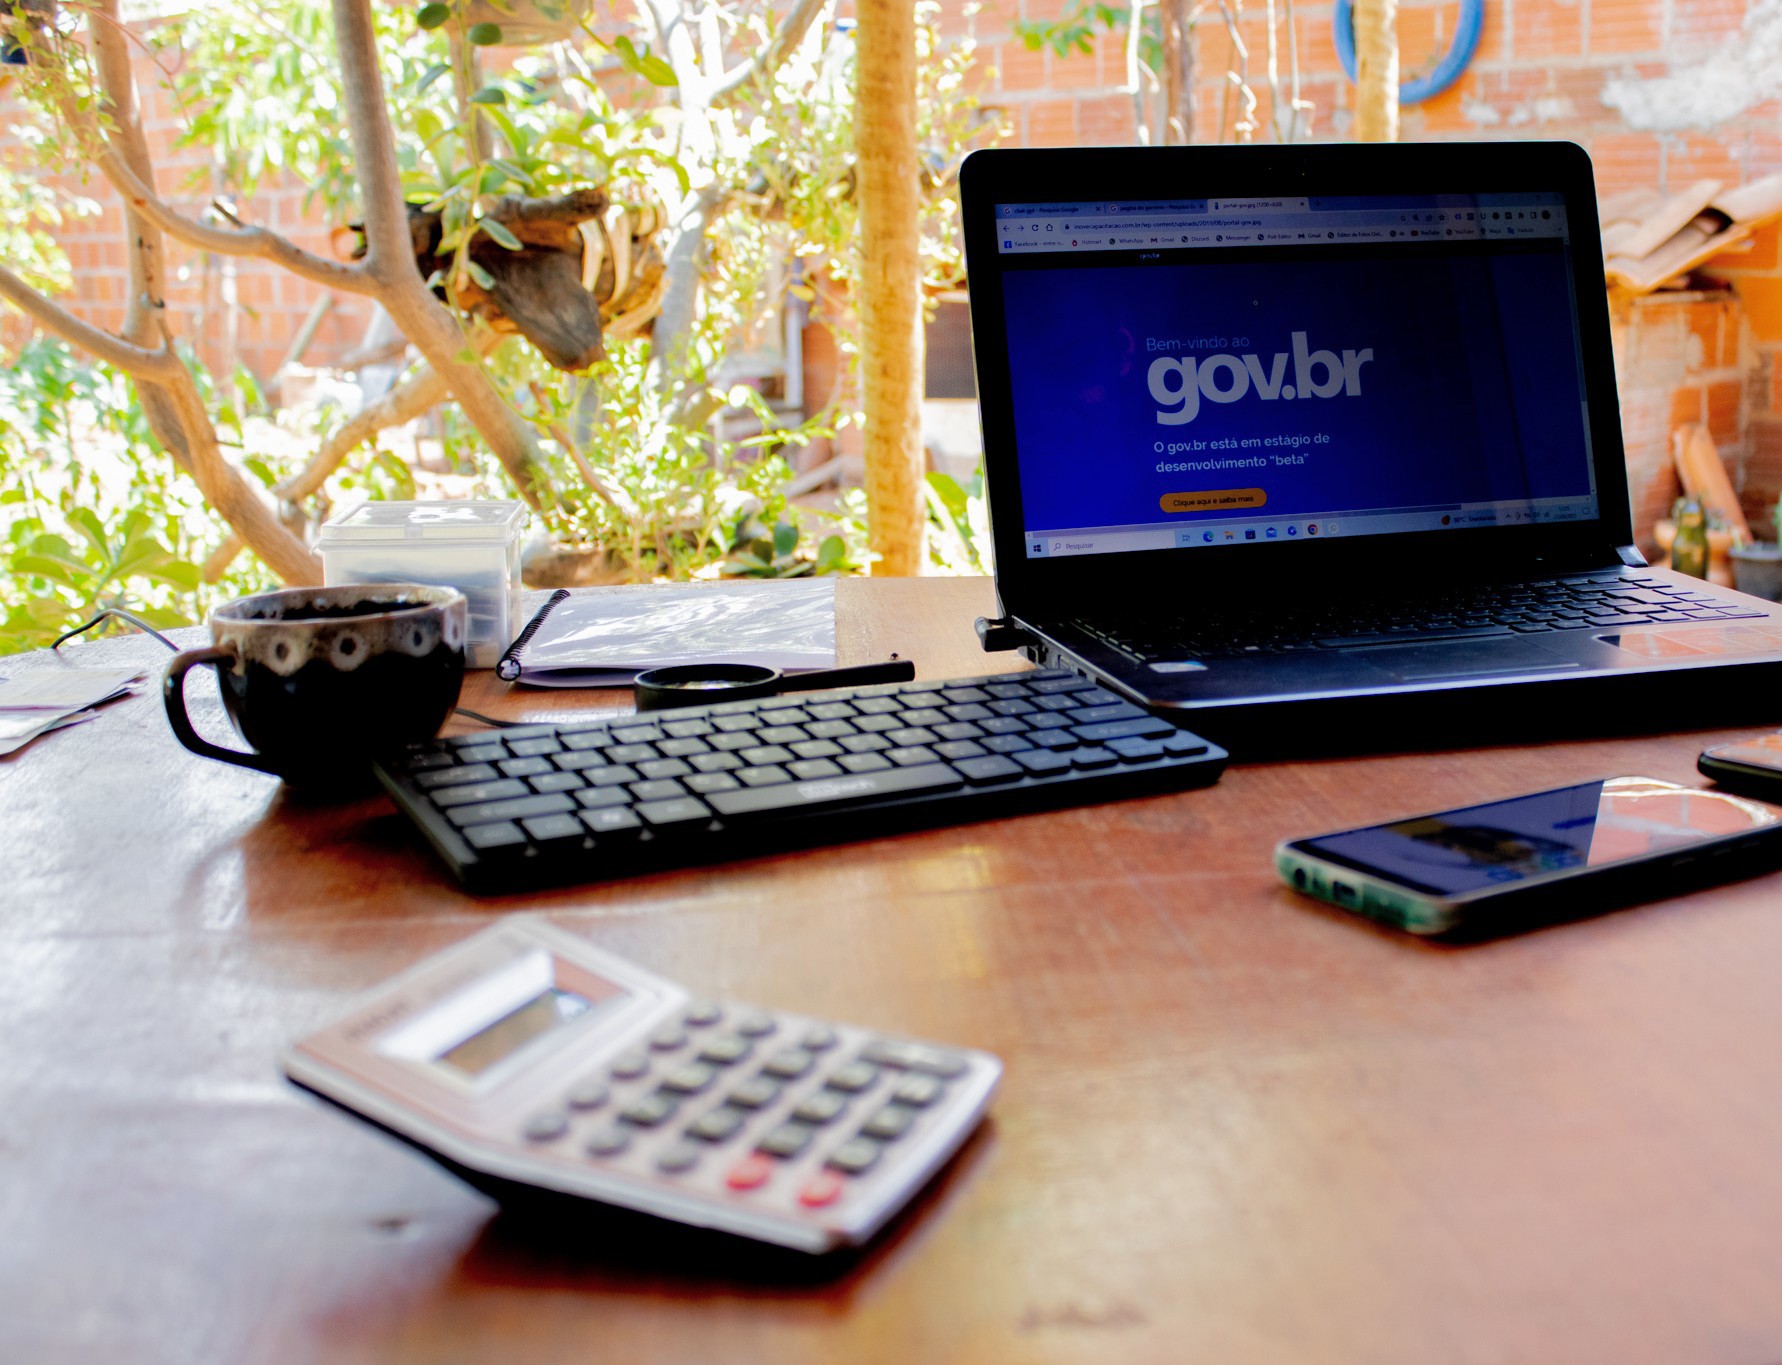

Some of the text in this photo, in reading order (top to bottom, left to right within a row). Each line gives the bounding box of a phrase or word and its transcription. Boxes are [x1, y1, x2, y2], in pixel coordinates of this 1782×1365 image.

[1146, 336, 1250, 351] Bem-vindo ao
[1147, 331, 1374, 426] gov.br
[1153, 432, 1330, 455] O gov.br está em estágio de
[1155, 457, 1267, 472] desenvolvimento
[1173, 498, 1196, 508] Clique
[1196, 498, 1212, 508] aqui
[1219, 496, 1237, 505] saiba
[1238, 495, 1254, 503] mais
[1065, 543, 1094, 551] Pesquisar
